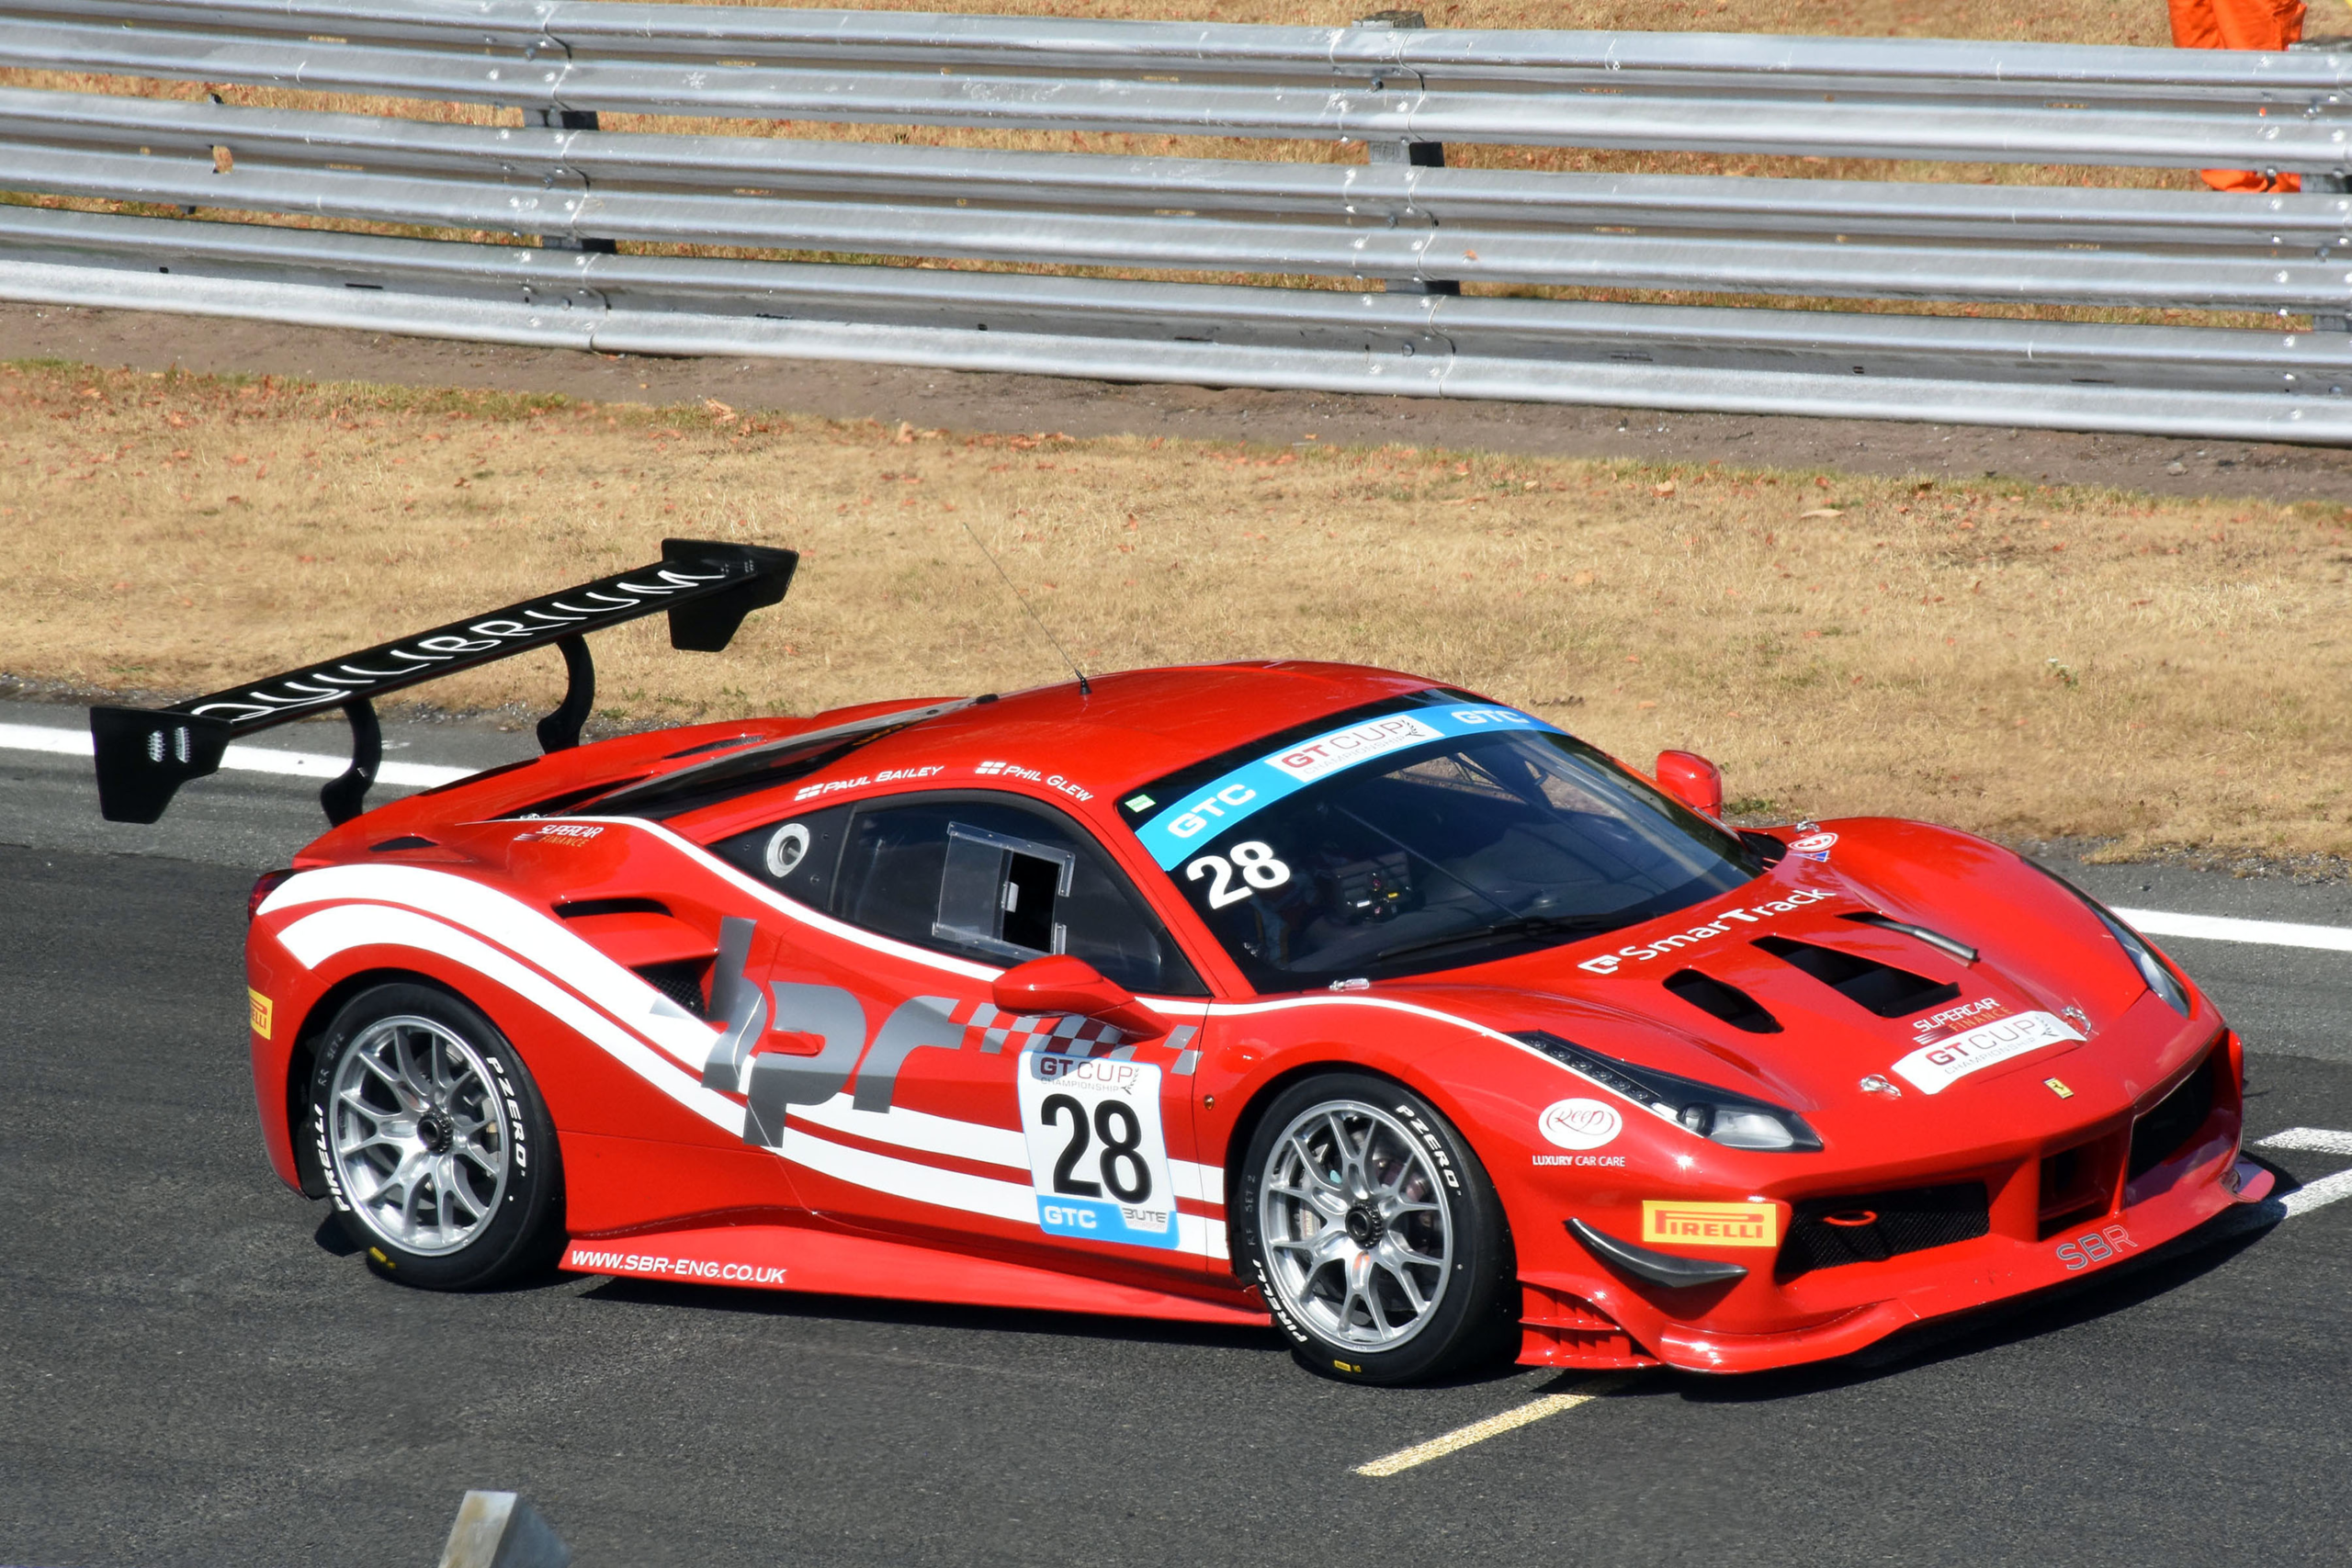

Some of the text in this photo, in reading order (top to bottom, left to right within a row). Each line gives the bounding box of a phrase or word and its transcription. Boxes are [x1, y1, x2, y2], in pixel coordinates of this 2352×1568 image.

[190, 568, 726, 721] QUILIBRIUM
[1452, 710, 1529, 725] GTC
[1282, 721, 1404, 769] GT CUP
[1303, 735, 1406, 775] CHAMPIONSHIP
[822, 765, 944, 793] PAUL BAILEY
[1002, 765, 1094, 802] PHIL GLEW
[1168, 784, 1257, 838] GTC
[536, 825, 605, 839] SUPERCAR
[538, 835, 589, 847] FINANCE
[1186, 840, 1290, 909] 28
[1913, 998, 2001, 1032] SUPERCAR
[1951, 1007, 2015, 1032] FINANCE
[1926, 1019, 2036, 1066] GT CUP
[1944, 1036, 2036, 1075] CHAMPIONSHIP
[1040, 1056, 1134, 1083] GT CUP
[1041, 1077, 1119, 1092] CHAMPIONSHIP
[314, 1103, 352, 1213] PIRELLI
[1041, 1093, 1152, 1204] 28
[1532, 1155, 1626, 1168] LUXURY CAR CARE
[1045, 1205, 1097, 1229] GTC
[1122, 1207, 1167, 1224] BUTE
[1655, 1209, 1765, 1239] PIRELLI
[2056, 1224, 2138, 1270] SBR
[571, 1250, 787, 1283] WWW.SBR-ENG.CO.UK
[1252, 1258, 1308, 1343] PIRELLI
